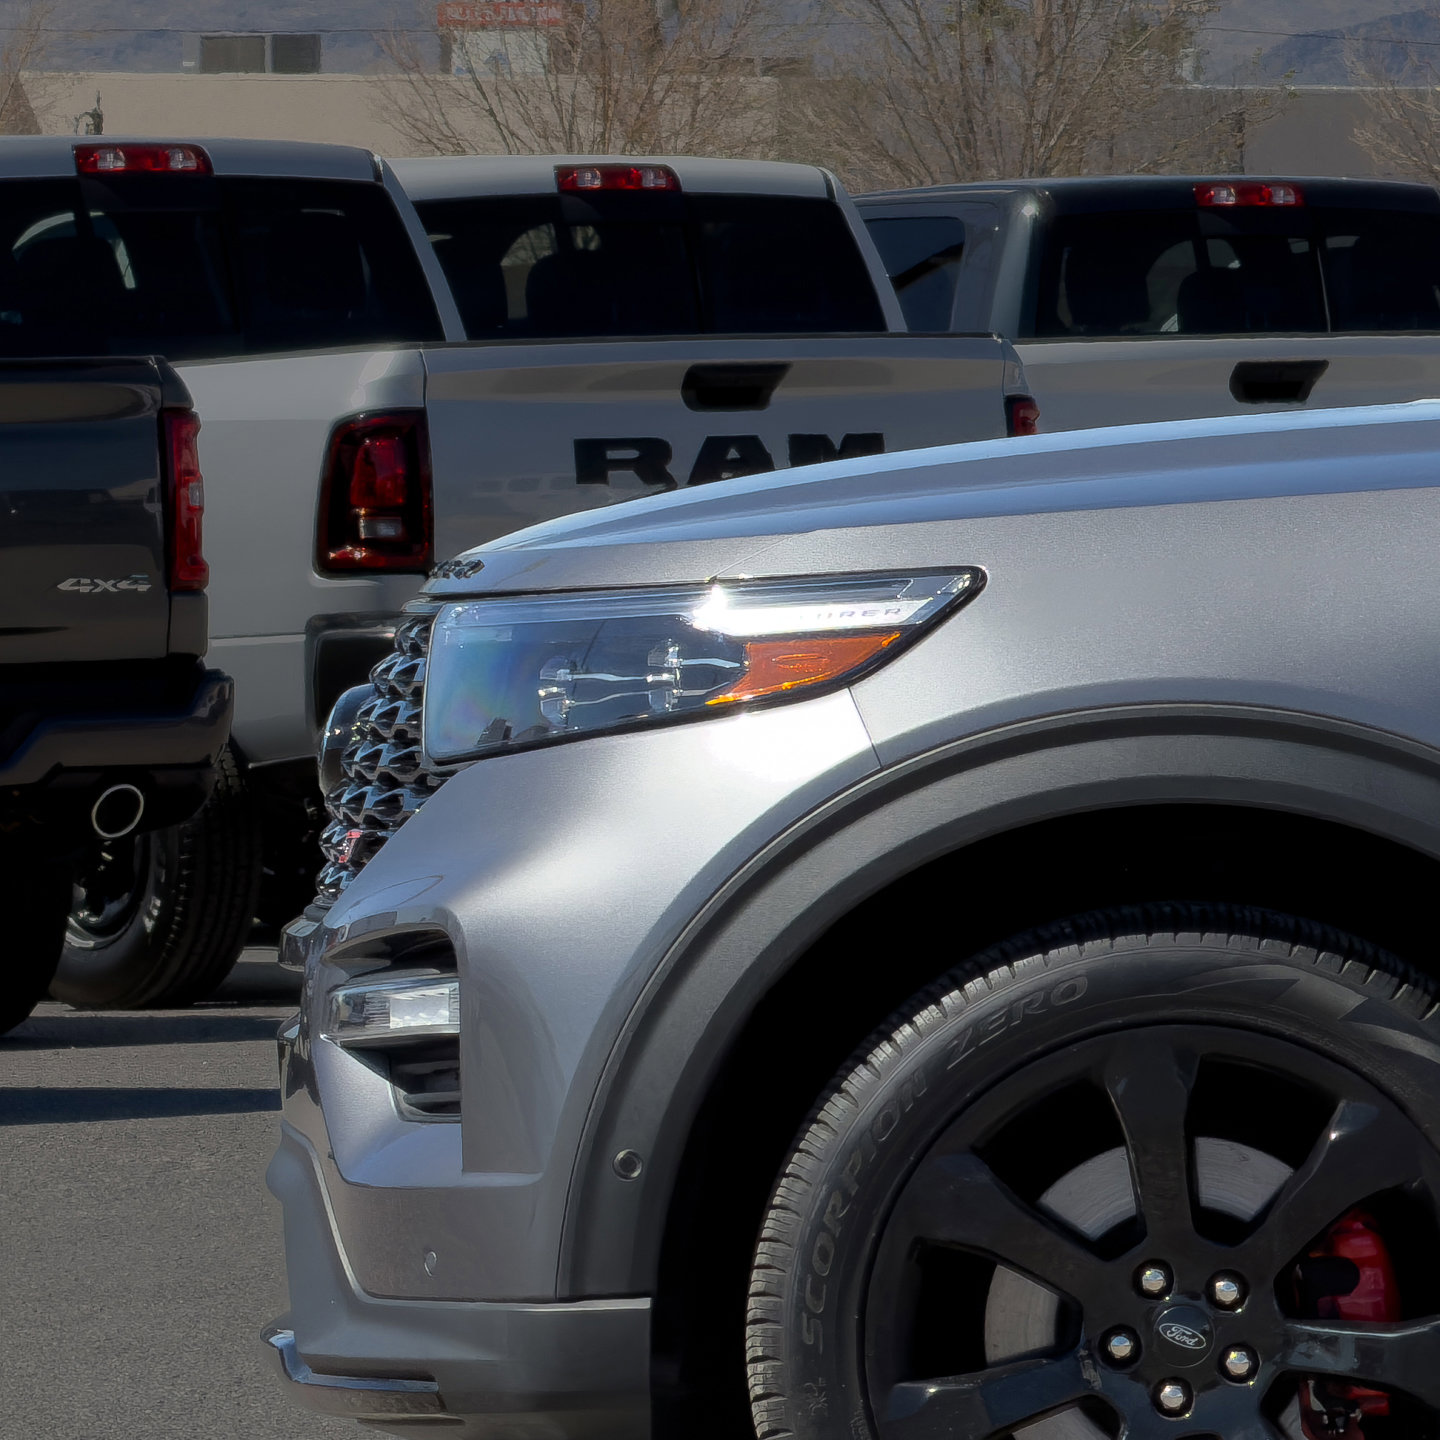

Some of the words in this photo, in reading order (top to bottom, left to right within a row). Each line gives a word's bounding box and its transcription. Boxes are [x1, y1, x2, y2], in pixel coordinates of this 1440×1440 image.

[800, 1068, 930, 1355] SCORPION
[946, 975, 1090, 1071] ZERO
[1165, 1324, 1200, 1347] Ford
